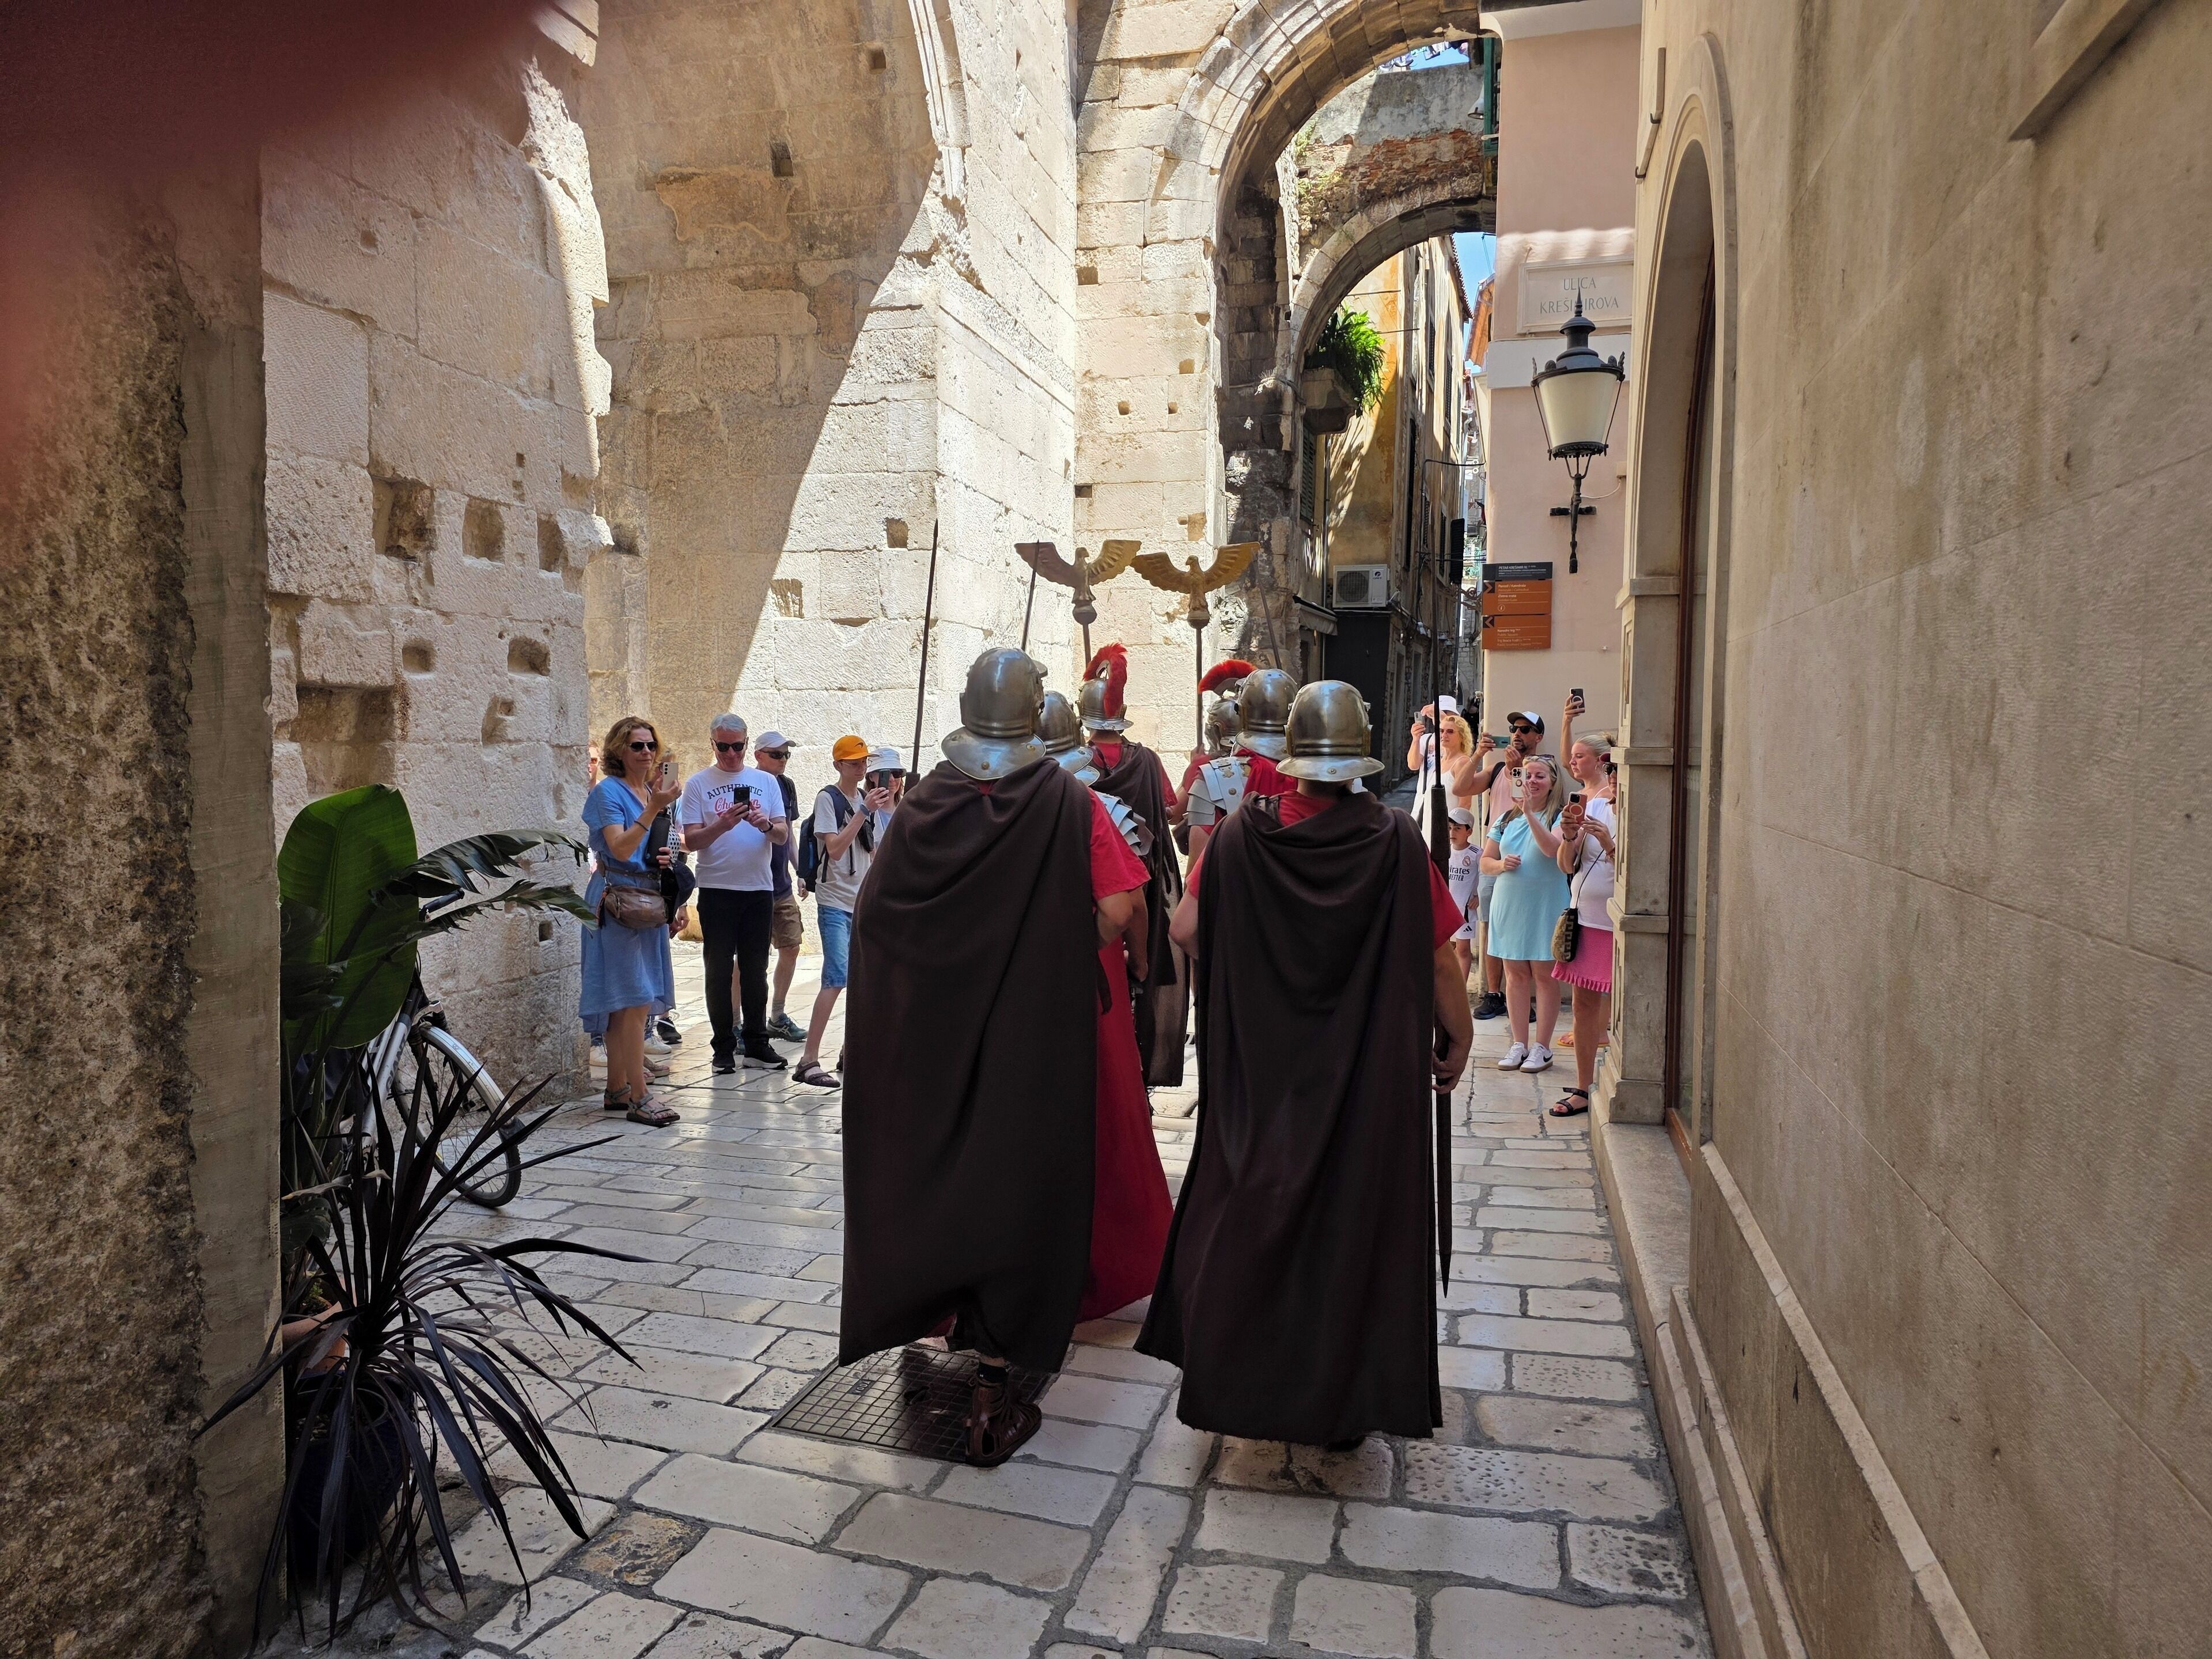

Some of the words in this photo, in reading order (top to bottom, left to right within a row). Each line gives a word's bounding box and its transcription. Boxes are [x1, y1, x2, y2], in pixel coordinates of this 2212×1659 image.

[1563, 276, 1596, 291] ULICA
[1540, 296, 1619, 314] KREŠIIROVA
[1450, 865, 1470, 875] irates
